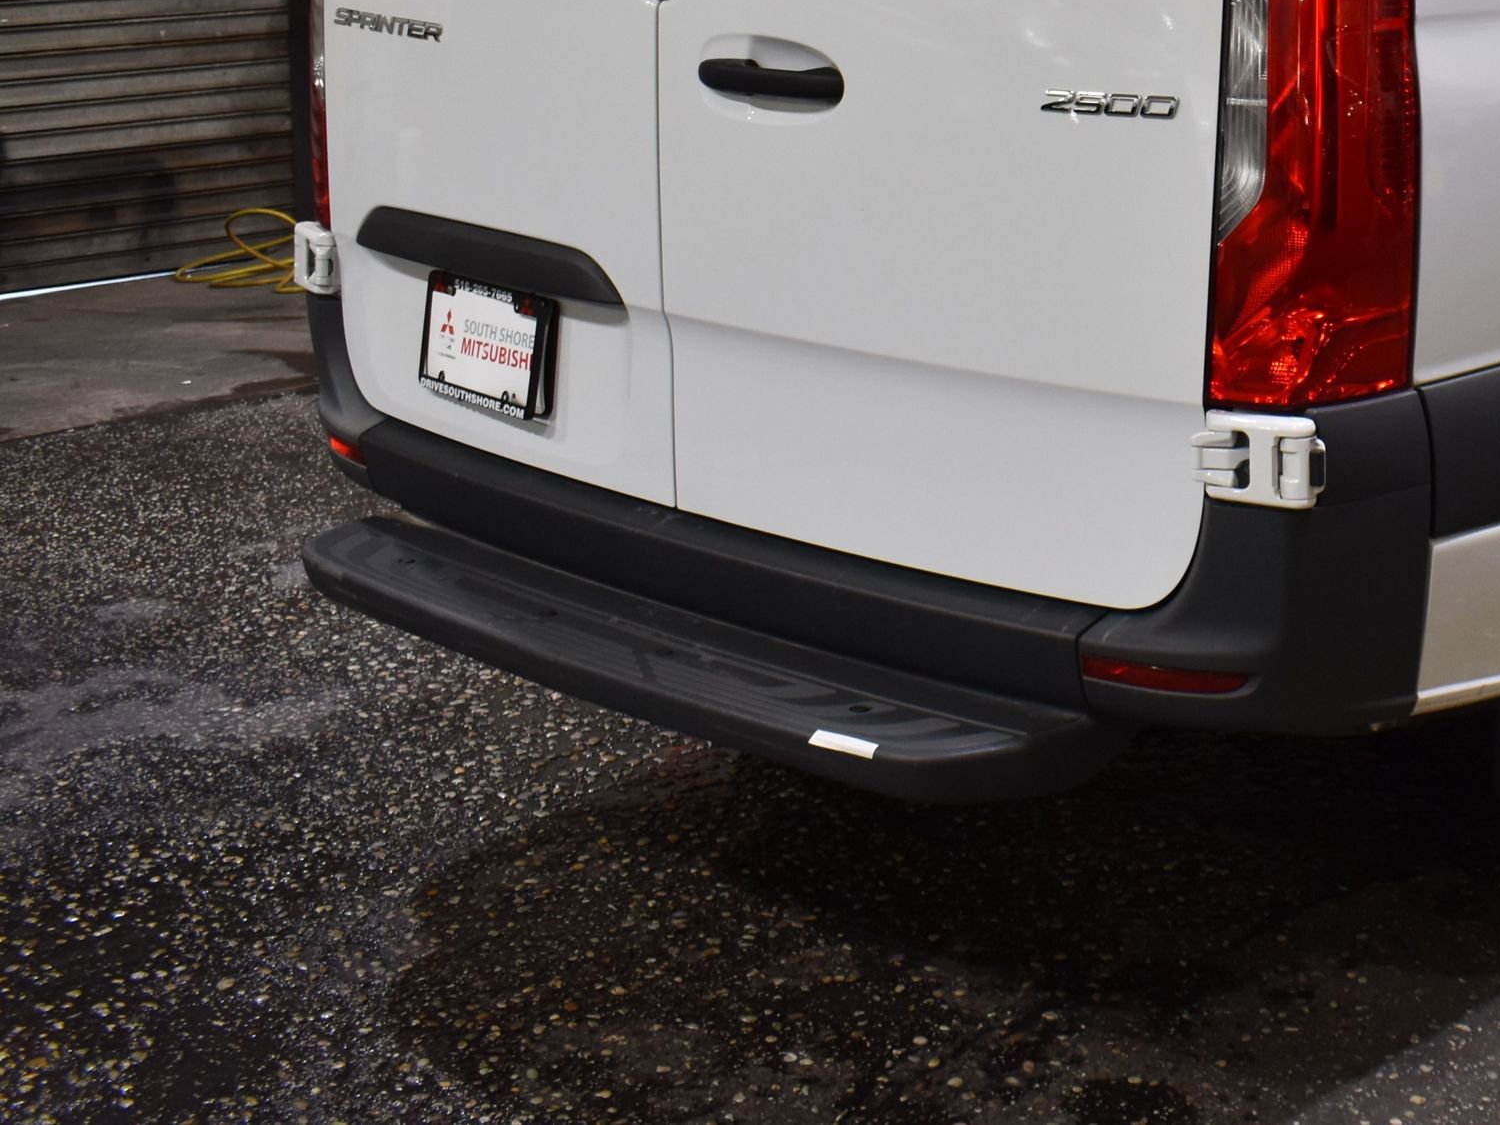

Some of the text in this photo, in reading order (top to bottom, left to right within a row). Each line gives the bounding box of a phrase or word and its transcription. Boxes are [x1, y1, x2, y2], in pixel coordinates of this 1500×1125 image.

[334, 7, 443, 43] SPRINTER
[1040, 89, 1179, 119] 2500
[464, 319, 535, 349] SOUTH SHORE
[420, 377, 525, 420] DRIVESOUTHSHORE.COM
